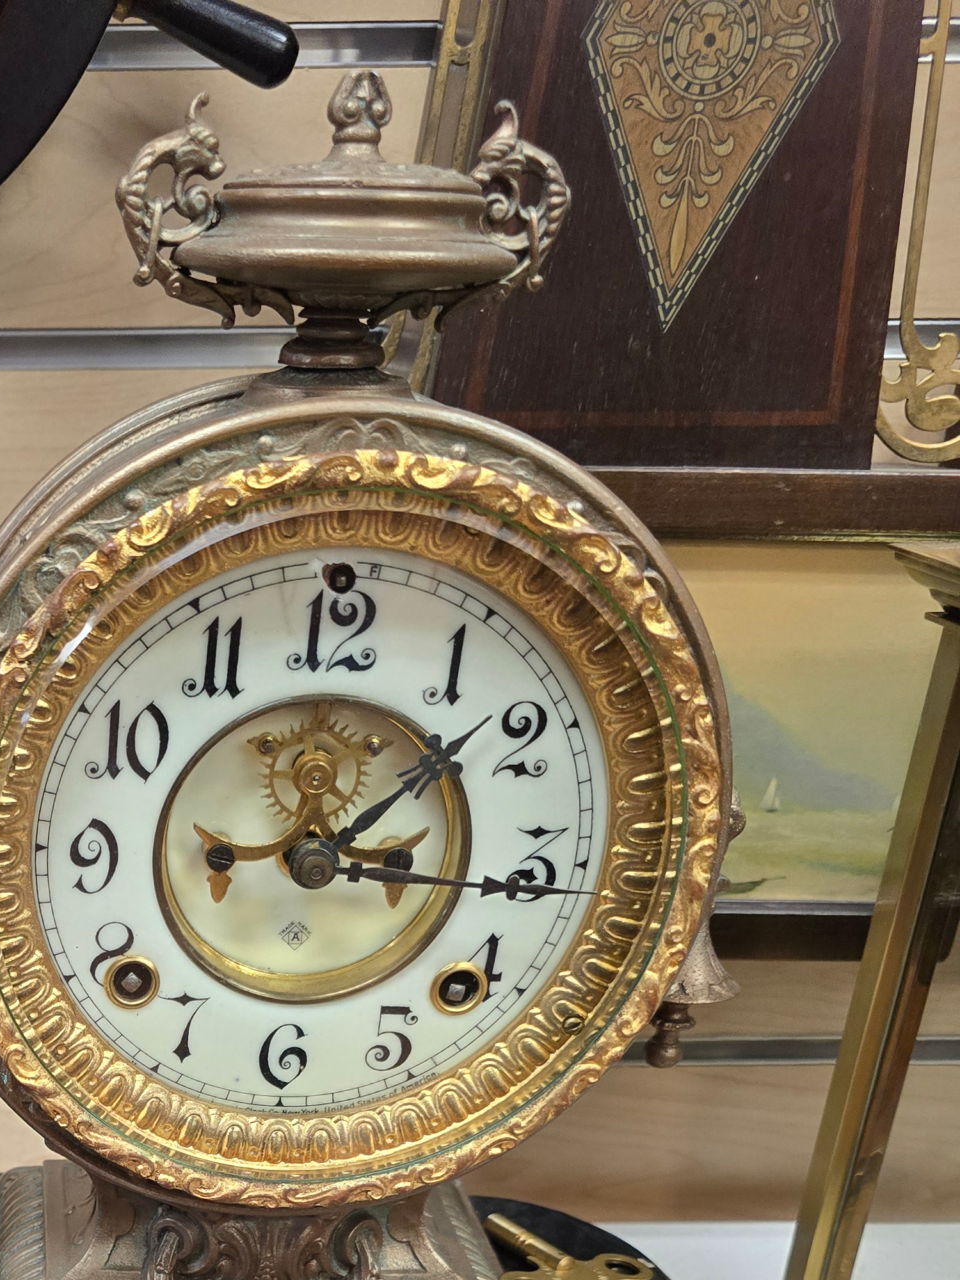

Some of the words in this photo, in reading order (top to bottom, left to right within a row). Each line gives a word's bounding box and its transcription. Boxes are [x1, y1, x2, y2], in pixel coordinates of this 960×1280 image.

[181, 616, 246, 699] 11
[286, 590, 377, 673] 12
[423, 623, 468, 706] 1
[84, 701, 169, 784] 10
[492, 701, 548, 778] 2
[70, 818, 119, 893] 9
[158, 991, 211, 1063] 7
[258, 1023, 308, 1091] 6
[364, 1005, 418, 1073] 5
[324, 1102, 355, 1114] United
